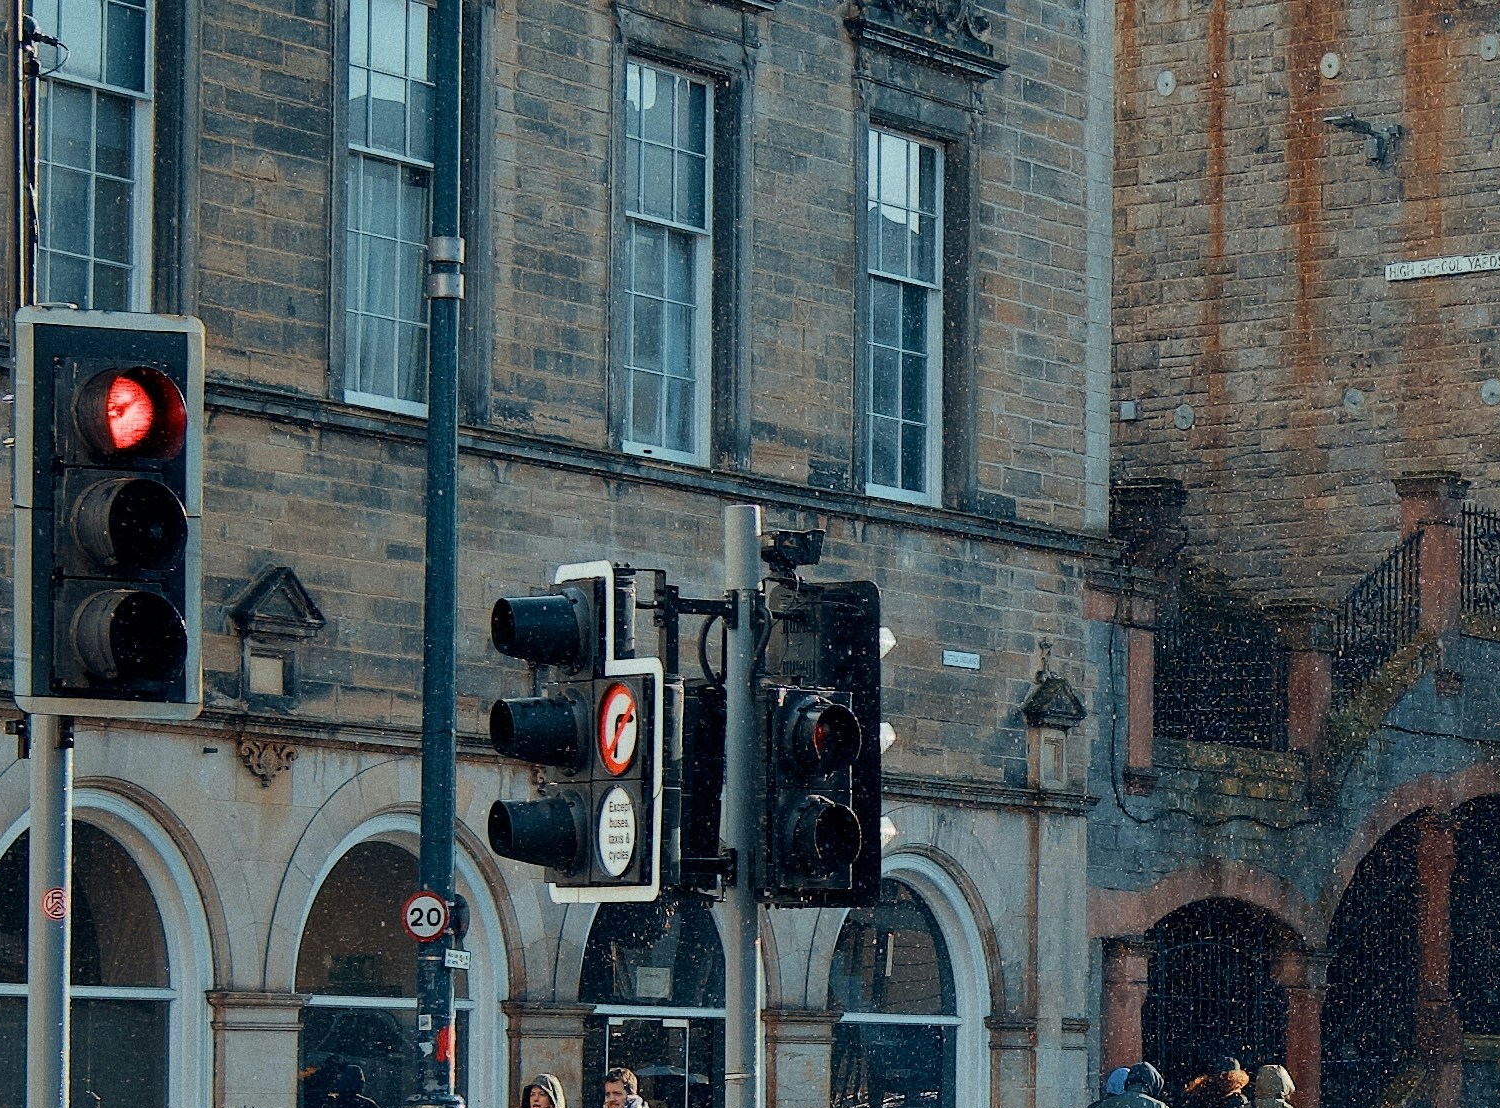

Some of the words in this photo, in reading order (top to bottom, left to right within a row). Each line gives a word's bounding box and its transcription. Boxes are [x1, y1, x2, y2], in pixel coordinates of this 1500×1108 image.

[1389, 266, 1415, 279] HIGH
[1419, 260, 1463, 275] SCHOOL
[608, 833, 624, 845] taxis
[609, 849, 630, 863] cycles
[410, 907, 442, 927] 20
